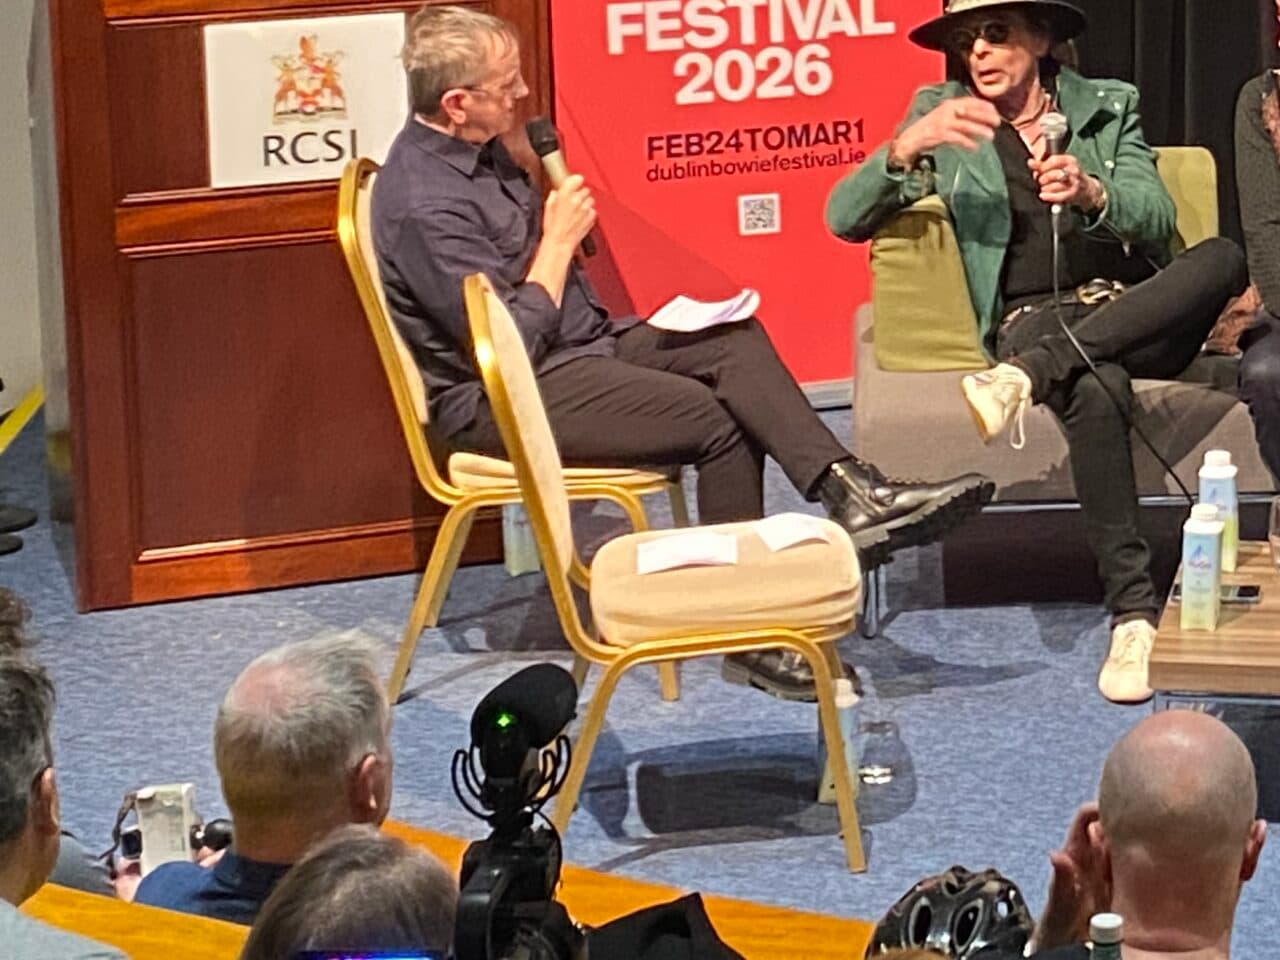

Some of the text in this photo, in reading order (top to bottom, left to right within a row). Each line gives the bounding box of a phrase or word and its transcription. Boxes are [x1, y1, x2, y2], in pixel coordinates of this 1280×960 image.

[673, 44, 833, 105] 2026
[263, 129, 358, 167] RCSI
[646, 148, 866, 182] dublinbowiefestival.ie
